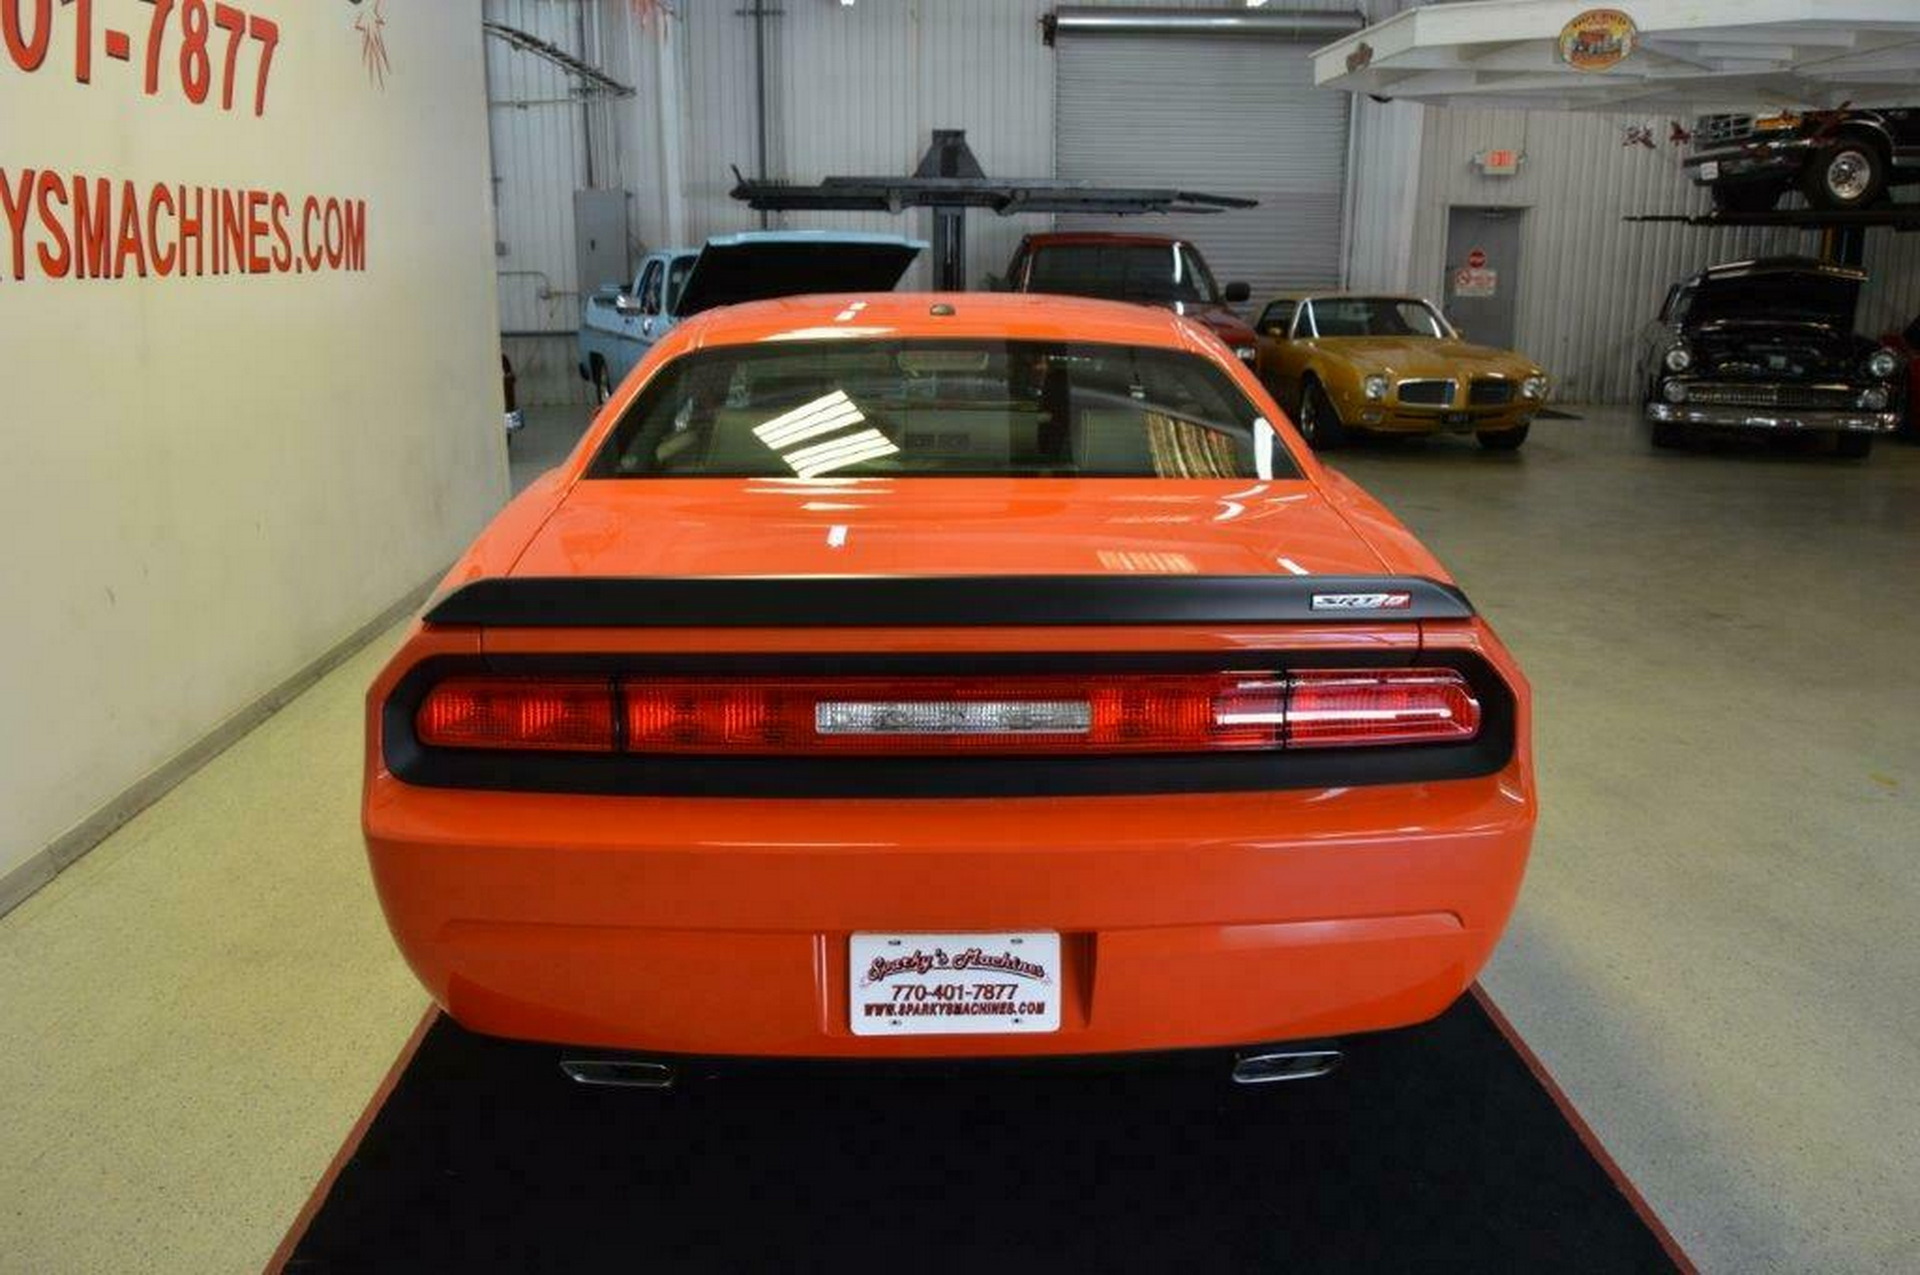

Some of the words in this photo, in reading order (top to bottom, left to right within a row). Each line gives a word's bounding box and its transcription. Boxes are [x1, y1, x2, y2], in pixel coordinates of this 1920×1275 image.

[0, 167, 366, 281] YSMACHINES.COM
[868, 949, 949, 982] Sparky's
[952, 948, 1045, 979] Machines
[892, 984, 1018, 1001] 770-401-7877
[864, 1001, 1046, 1017] WWW.SPARKYSMACHINES.COM
